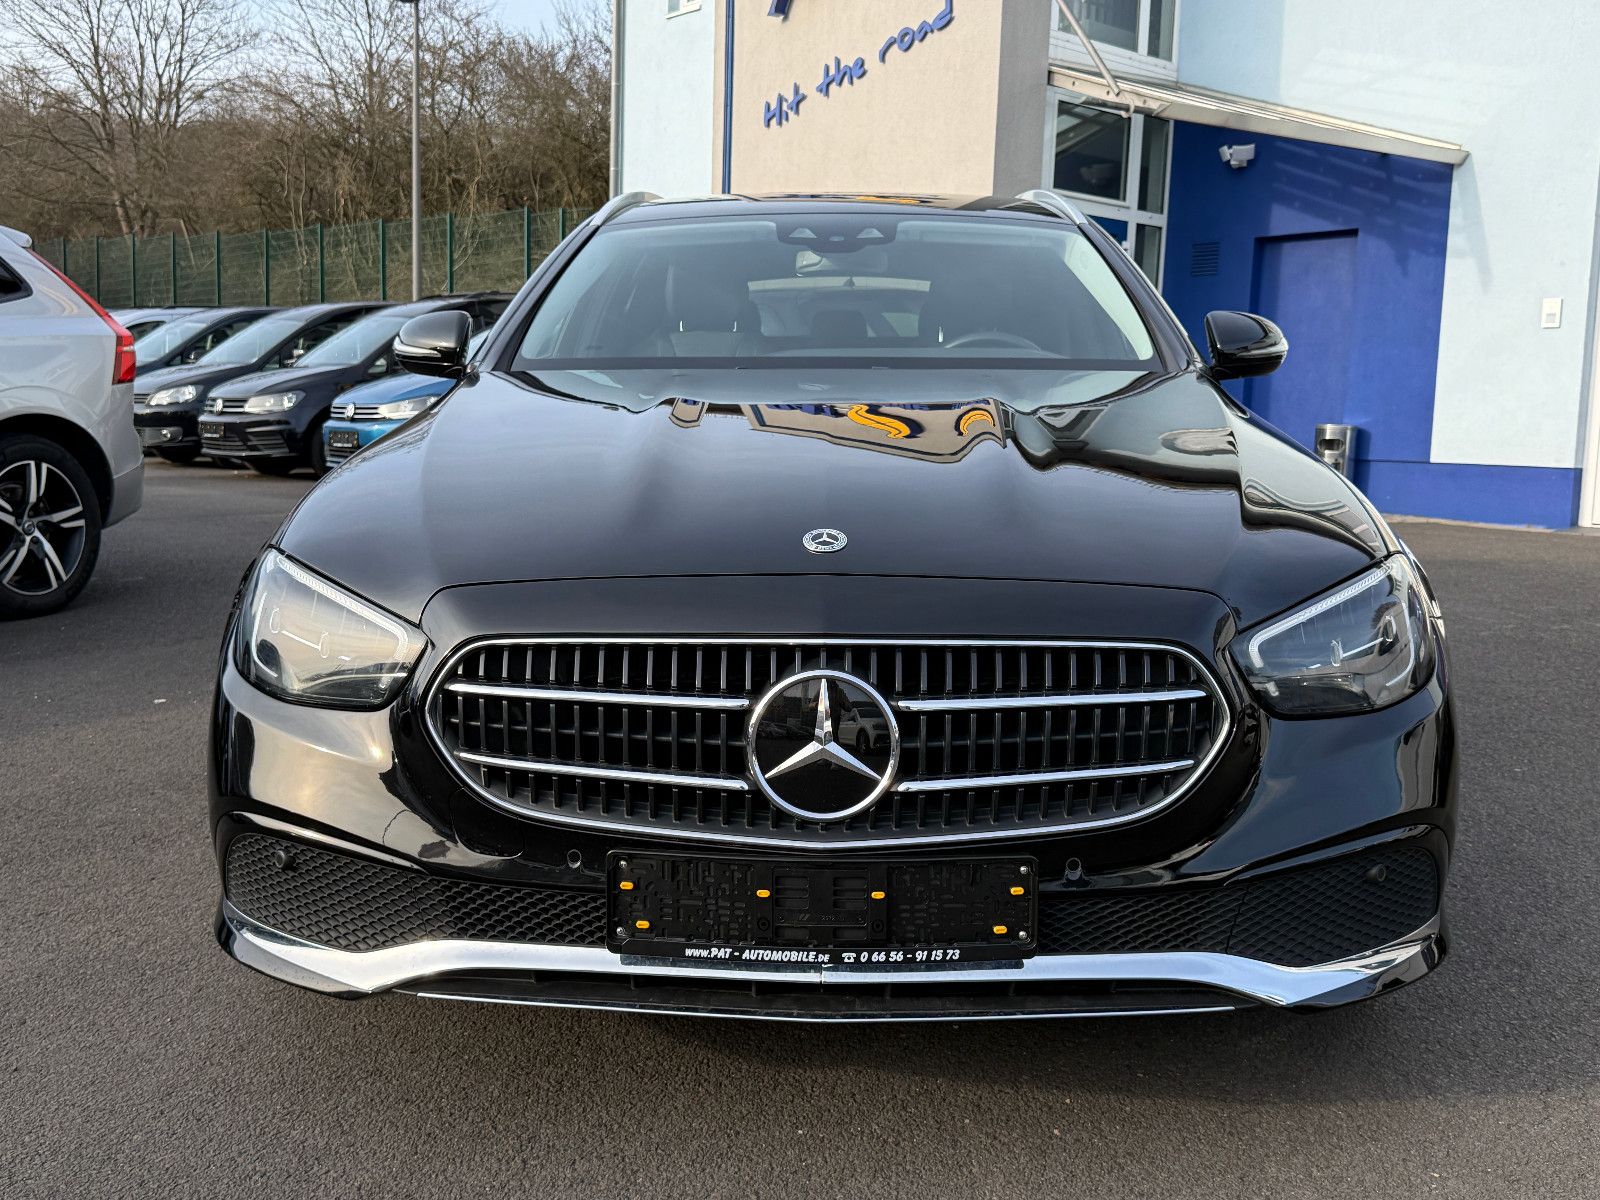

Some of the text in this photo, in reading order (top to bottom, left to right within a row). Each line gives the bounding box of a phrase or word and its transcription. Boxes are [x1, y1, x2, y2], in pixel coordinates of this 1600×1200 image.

[763, 0, 954, 128] Hit the road
[685, 947, 732, 959] www.PAT
[860, 951, 869, 963] 0
[871, 951, 887, 963] 66
[888, 950, 904, 963] 56
[915, 950, 928, 962] 91
[930, 949, 943, 961] 15
[946, 948, 961, 961] 73
